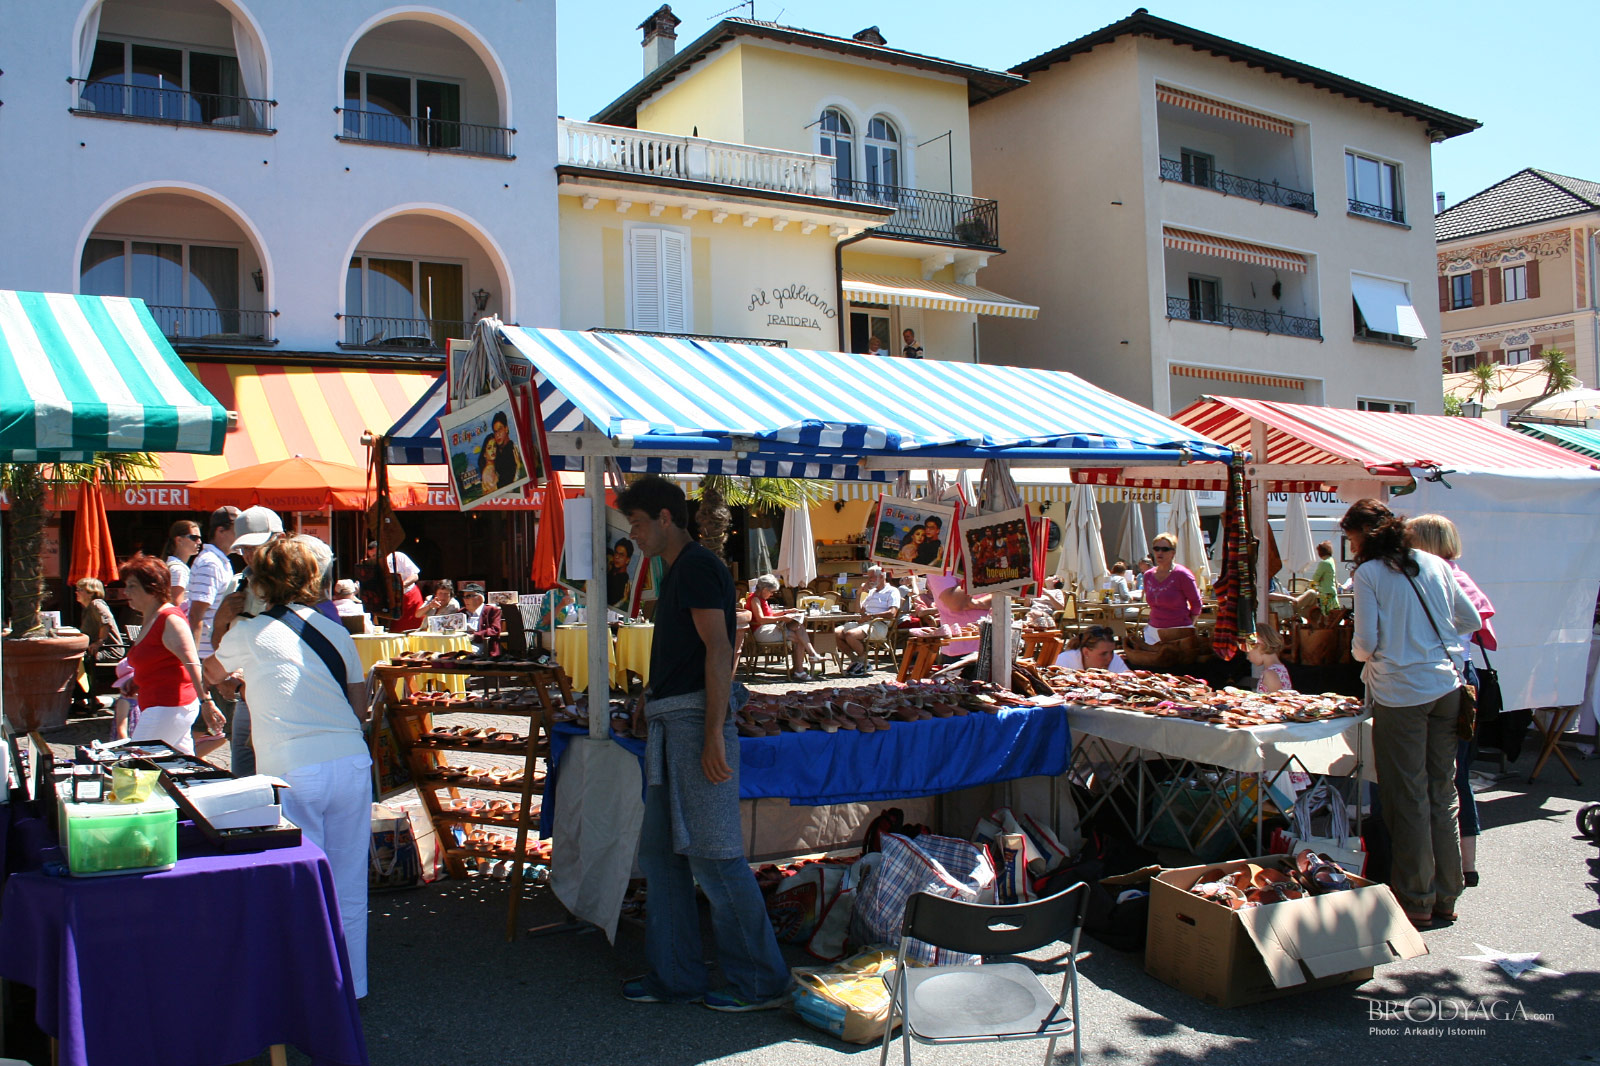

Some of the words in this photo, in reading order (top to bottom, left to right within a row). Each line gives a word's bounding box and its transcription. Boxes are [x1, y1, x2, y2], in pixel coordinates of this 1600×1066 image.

[748, 290, 770, 311] Al
[772, 284, 837, 318] gabbiano
[767, 314, 820, 329] TRATTORIA
[125, 488, 190, 505] OSTERI
[1121, 490, 1162, 501] Pizzeria
